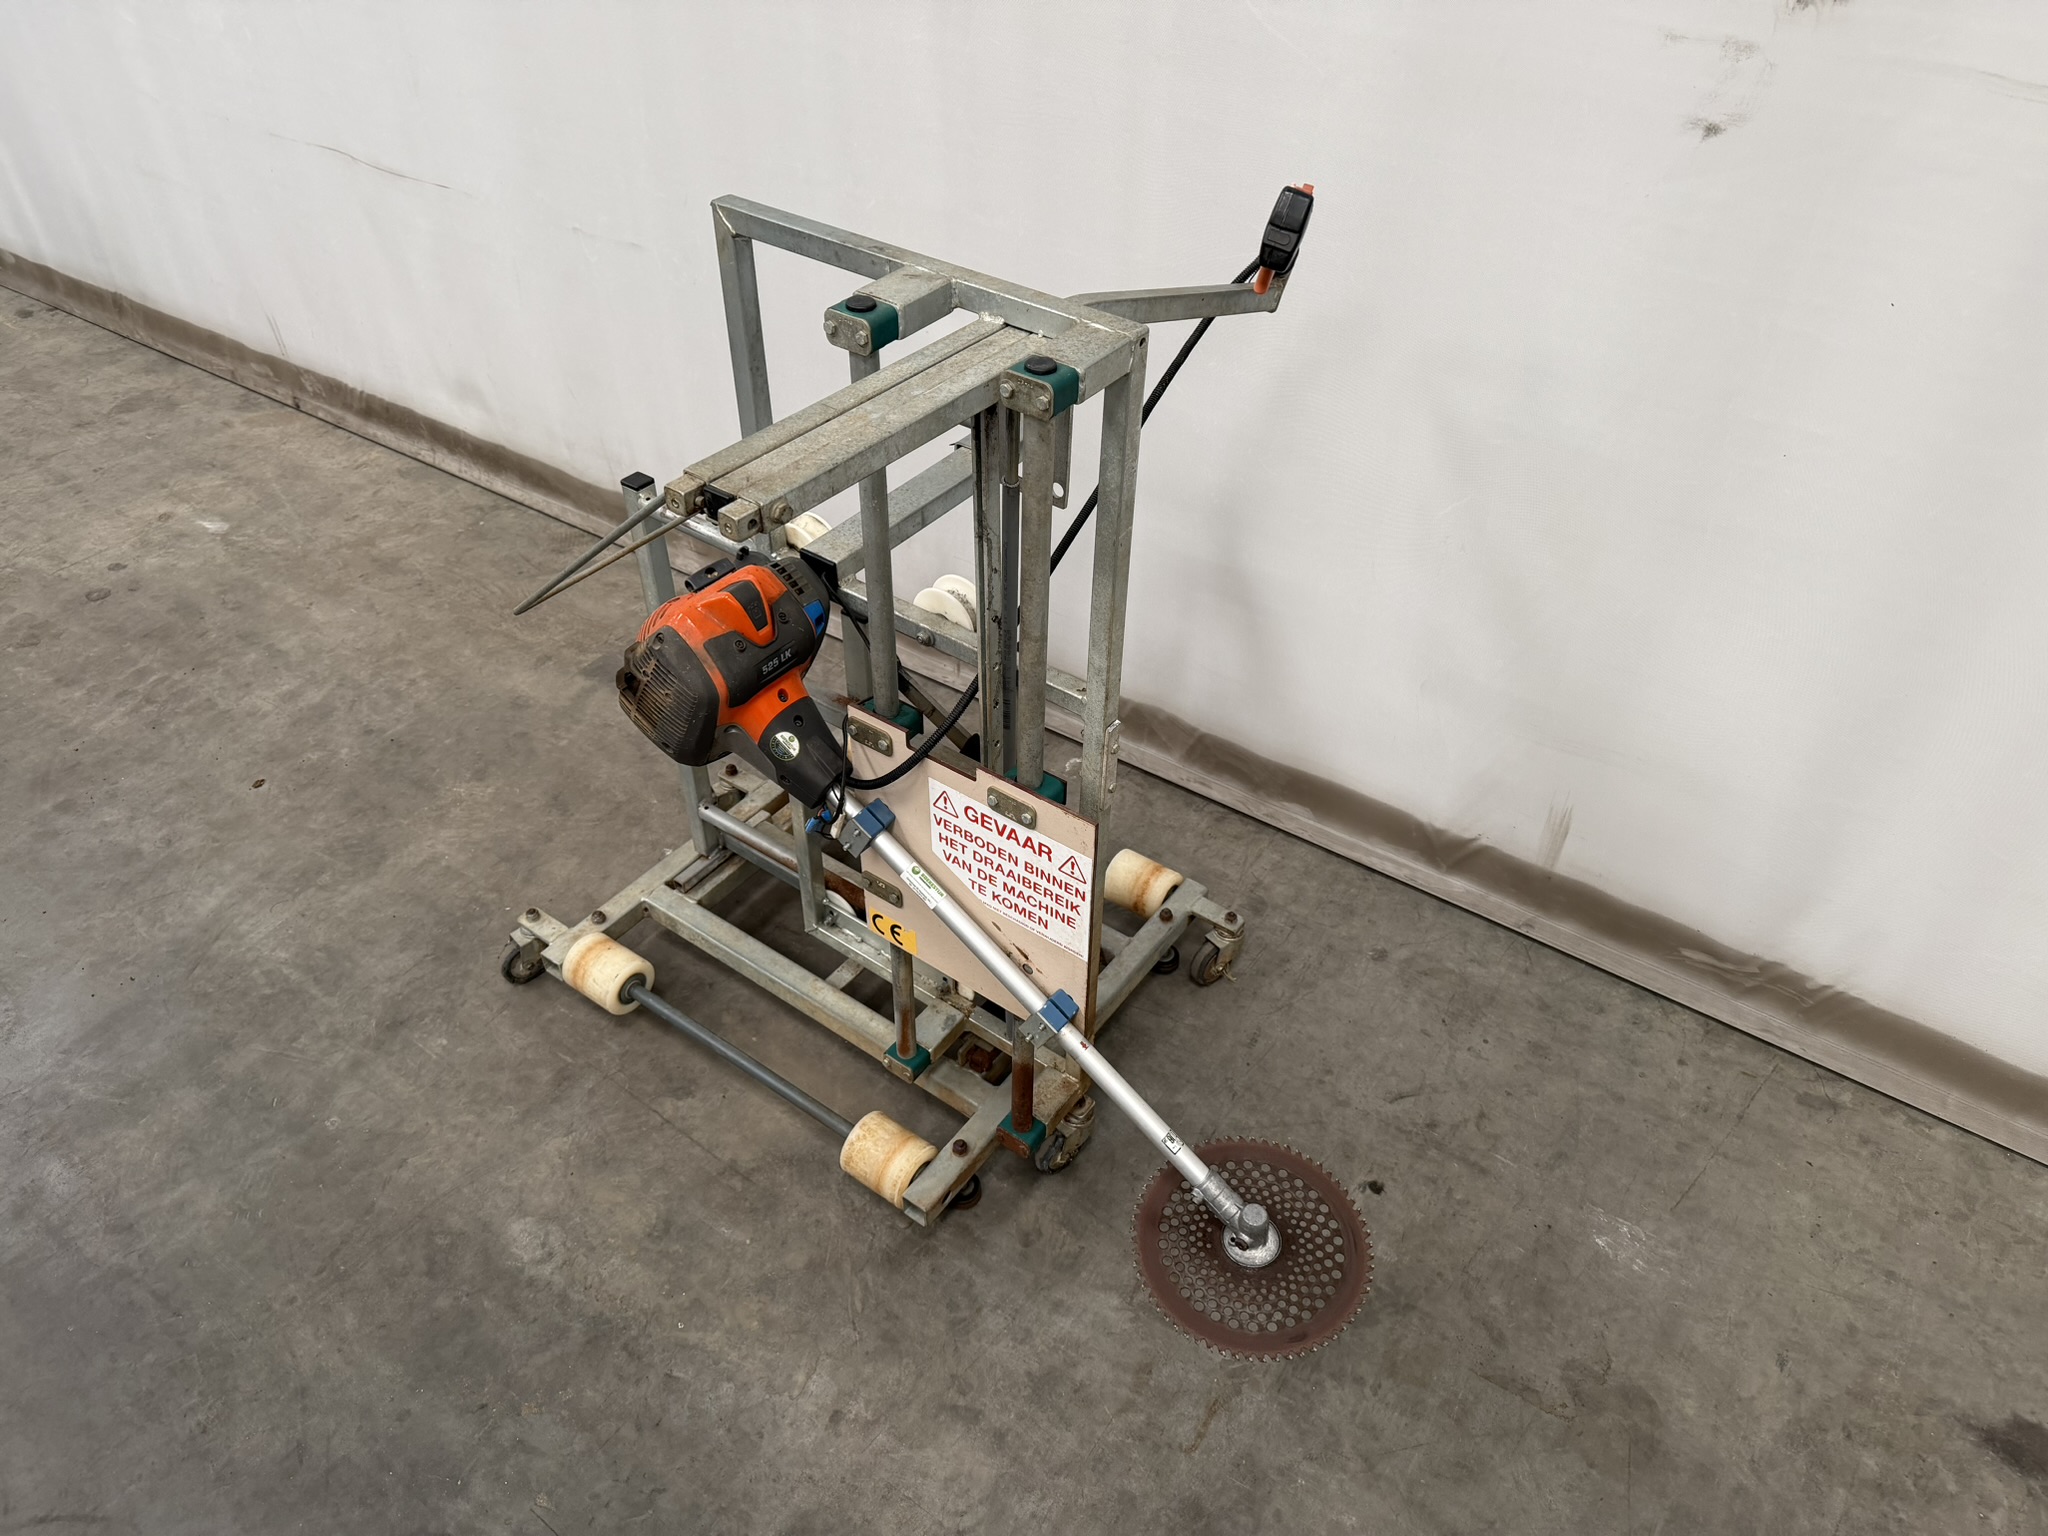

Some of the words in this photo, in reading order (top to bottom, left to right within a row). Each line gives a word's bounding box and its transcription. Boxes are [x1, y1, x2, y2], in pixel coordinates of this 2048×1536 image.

[762, 657, 779, 675] 525
[780, 649, 792, 662] LK
[933, 813, 1019, 867] VERBODEN
[1024, 861, 1086, 902] BINNEN
[964, 805, 1053, 862] GEVAAR
[938, 832, 968, 855] HET
[972, 849, 1080, 916] DRAAIBEREIK
[943, 849, 972, 874] VAN
[977, 868, 998, 888] DE
[1002, 881, 1077, 930] MACHINE
[872, 914, 903, 946] CE
[968, 877, 987, 897] TE
[991, 890, 1049, 929] KOMEN
